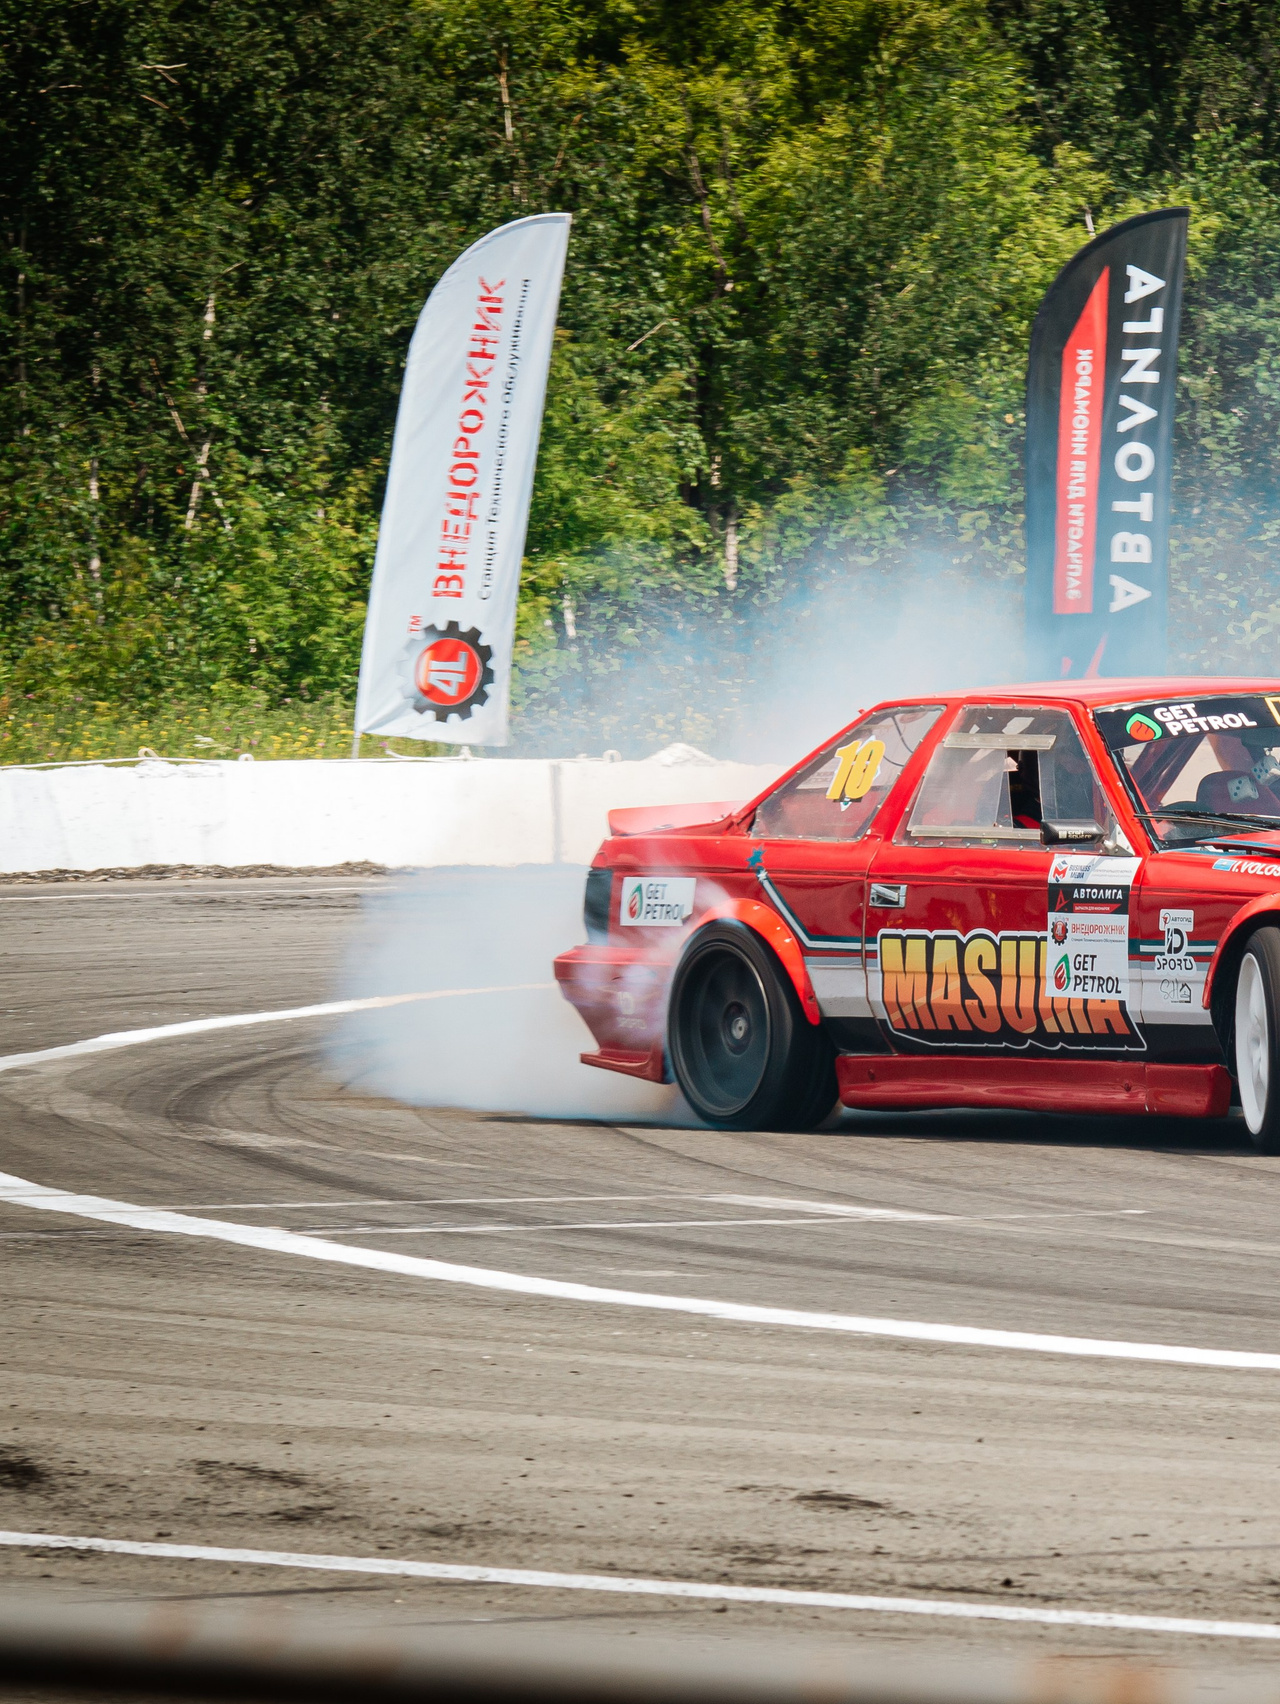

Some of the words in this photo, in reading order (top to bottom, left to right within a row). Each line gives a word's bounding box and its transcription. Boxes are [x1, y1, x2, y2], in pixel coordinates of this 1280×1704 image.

[501, 278, 532, 405] Обслуживания
[431, 276, 507, 599] ВНЕДОРОЖНИК
[485, 409, 512, 525] Технического
[477, 531, 499, 600] Станция
[427, 651, 469, 696] 4L
[1153, 703, 1197, 722] GET
[1165, 712, 1258, 736] PETROL
[825, 739, 886, 799] 10
[646, 883, 668, 900] GET
[1073, 888, 1123, 900] АВТОЛИГА
[1071, 923, 1125, 936] ВНЕДОРОЖНИК
[1073, 953, 1097, 971] GET
[1073, 975, 1122, 994] PETROL
